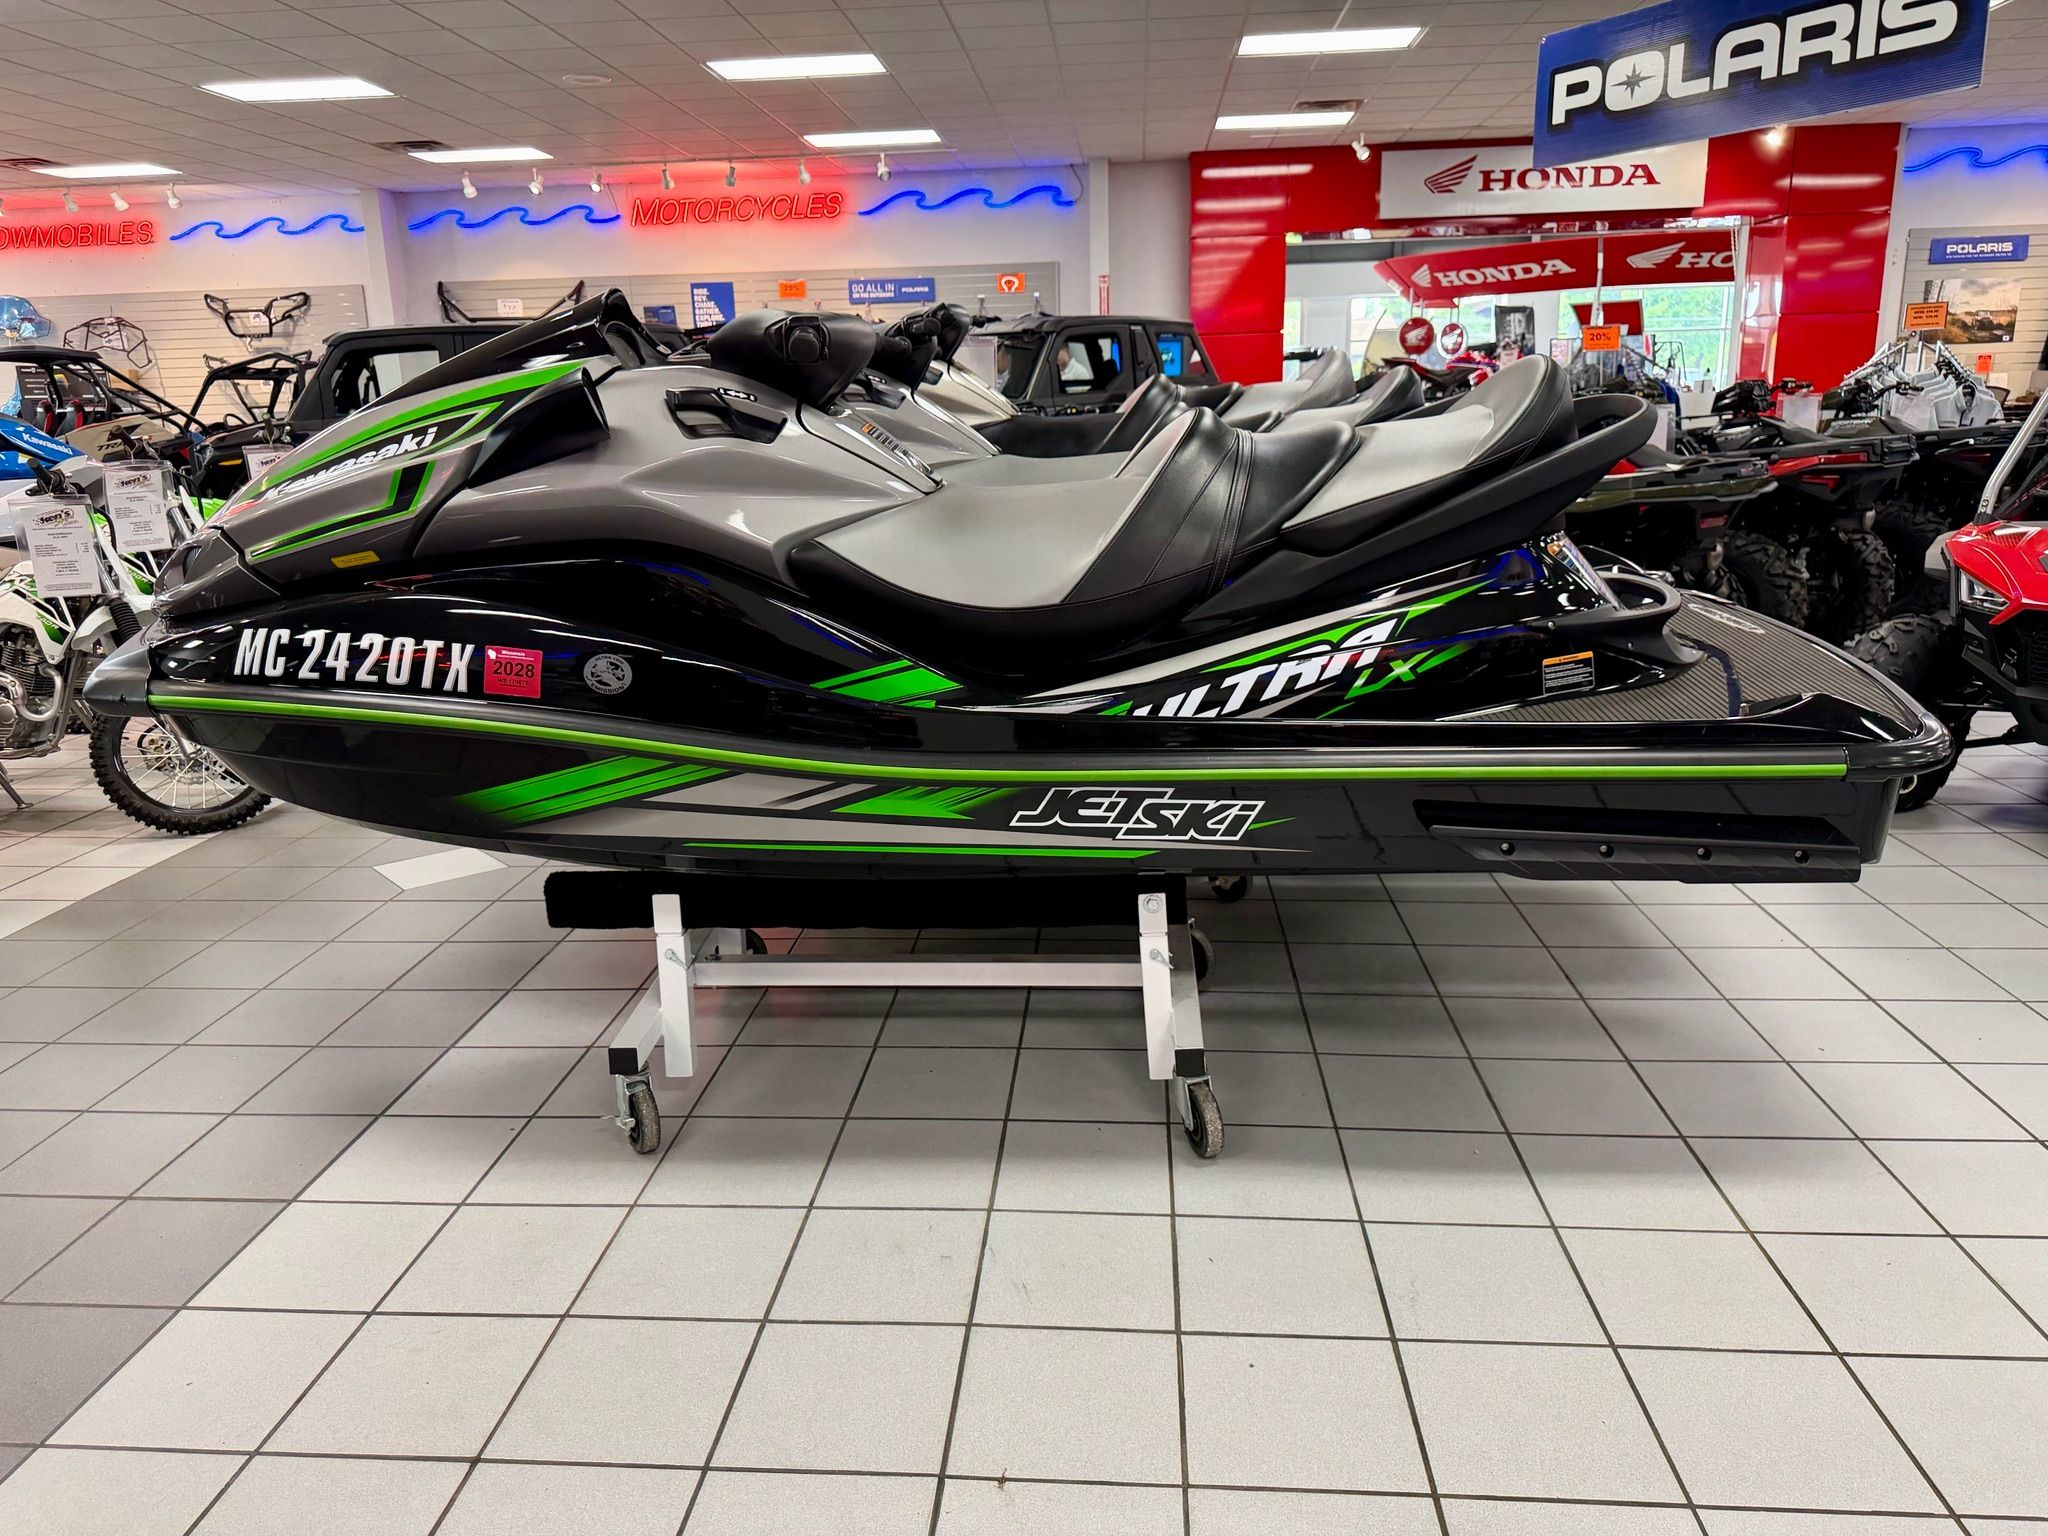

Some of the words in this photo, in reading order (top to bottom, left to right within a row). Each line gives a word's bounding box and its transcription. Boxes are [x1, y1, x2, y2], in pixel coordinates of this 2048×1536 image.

[1551, 0, 1958, 126] POLARIS
[1478, 163, 1661, 193] HONDA
[631, 192, 843, 227] MOTORCYCLES
[1946, 242, 2014, 254] POLARIS
[1432, 258, 1576, 287] HONDA
[852, 283, 864, 293] GO
[866, 283, 883, 293] ALL
[885, 283, 895, 293] IN
[1589, 332, 1611, 342] 20%
[22, 432, 74, 455] Kawasaki
[262, 426, 438, 500] Kawasaki
[233, 627, 291, 678] MC
[493, 660, 535, 679] 2028
[1132, 618, 1399, 718] ULTRA
[1344, 649, 1435, 700] LX
